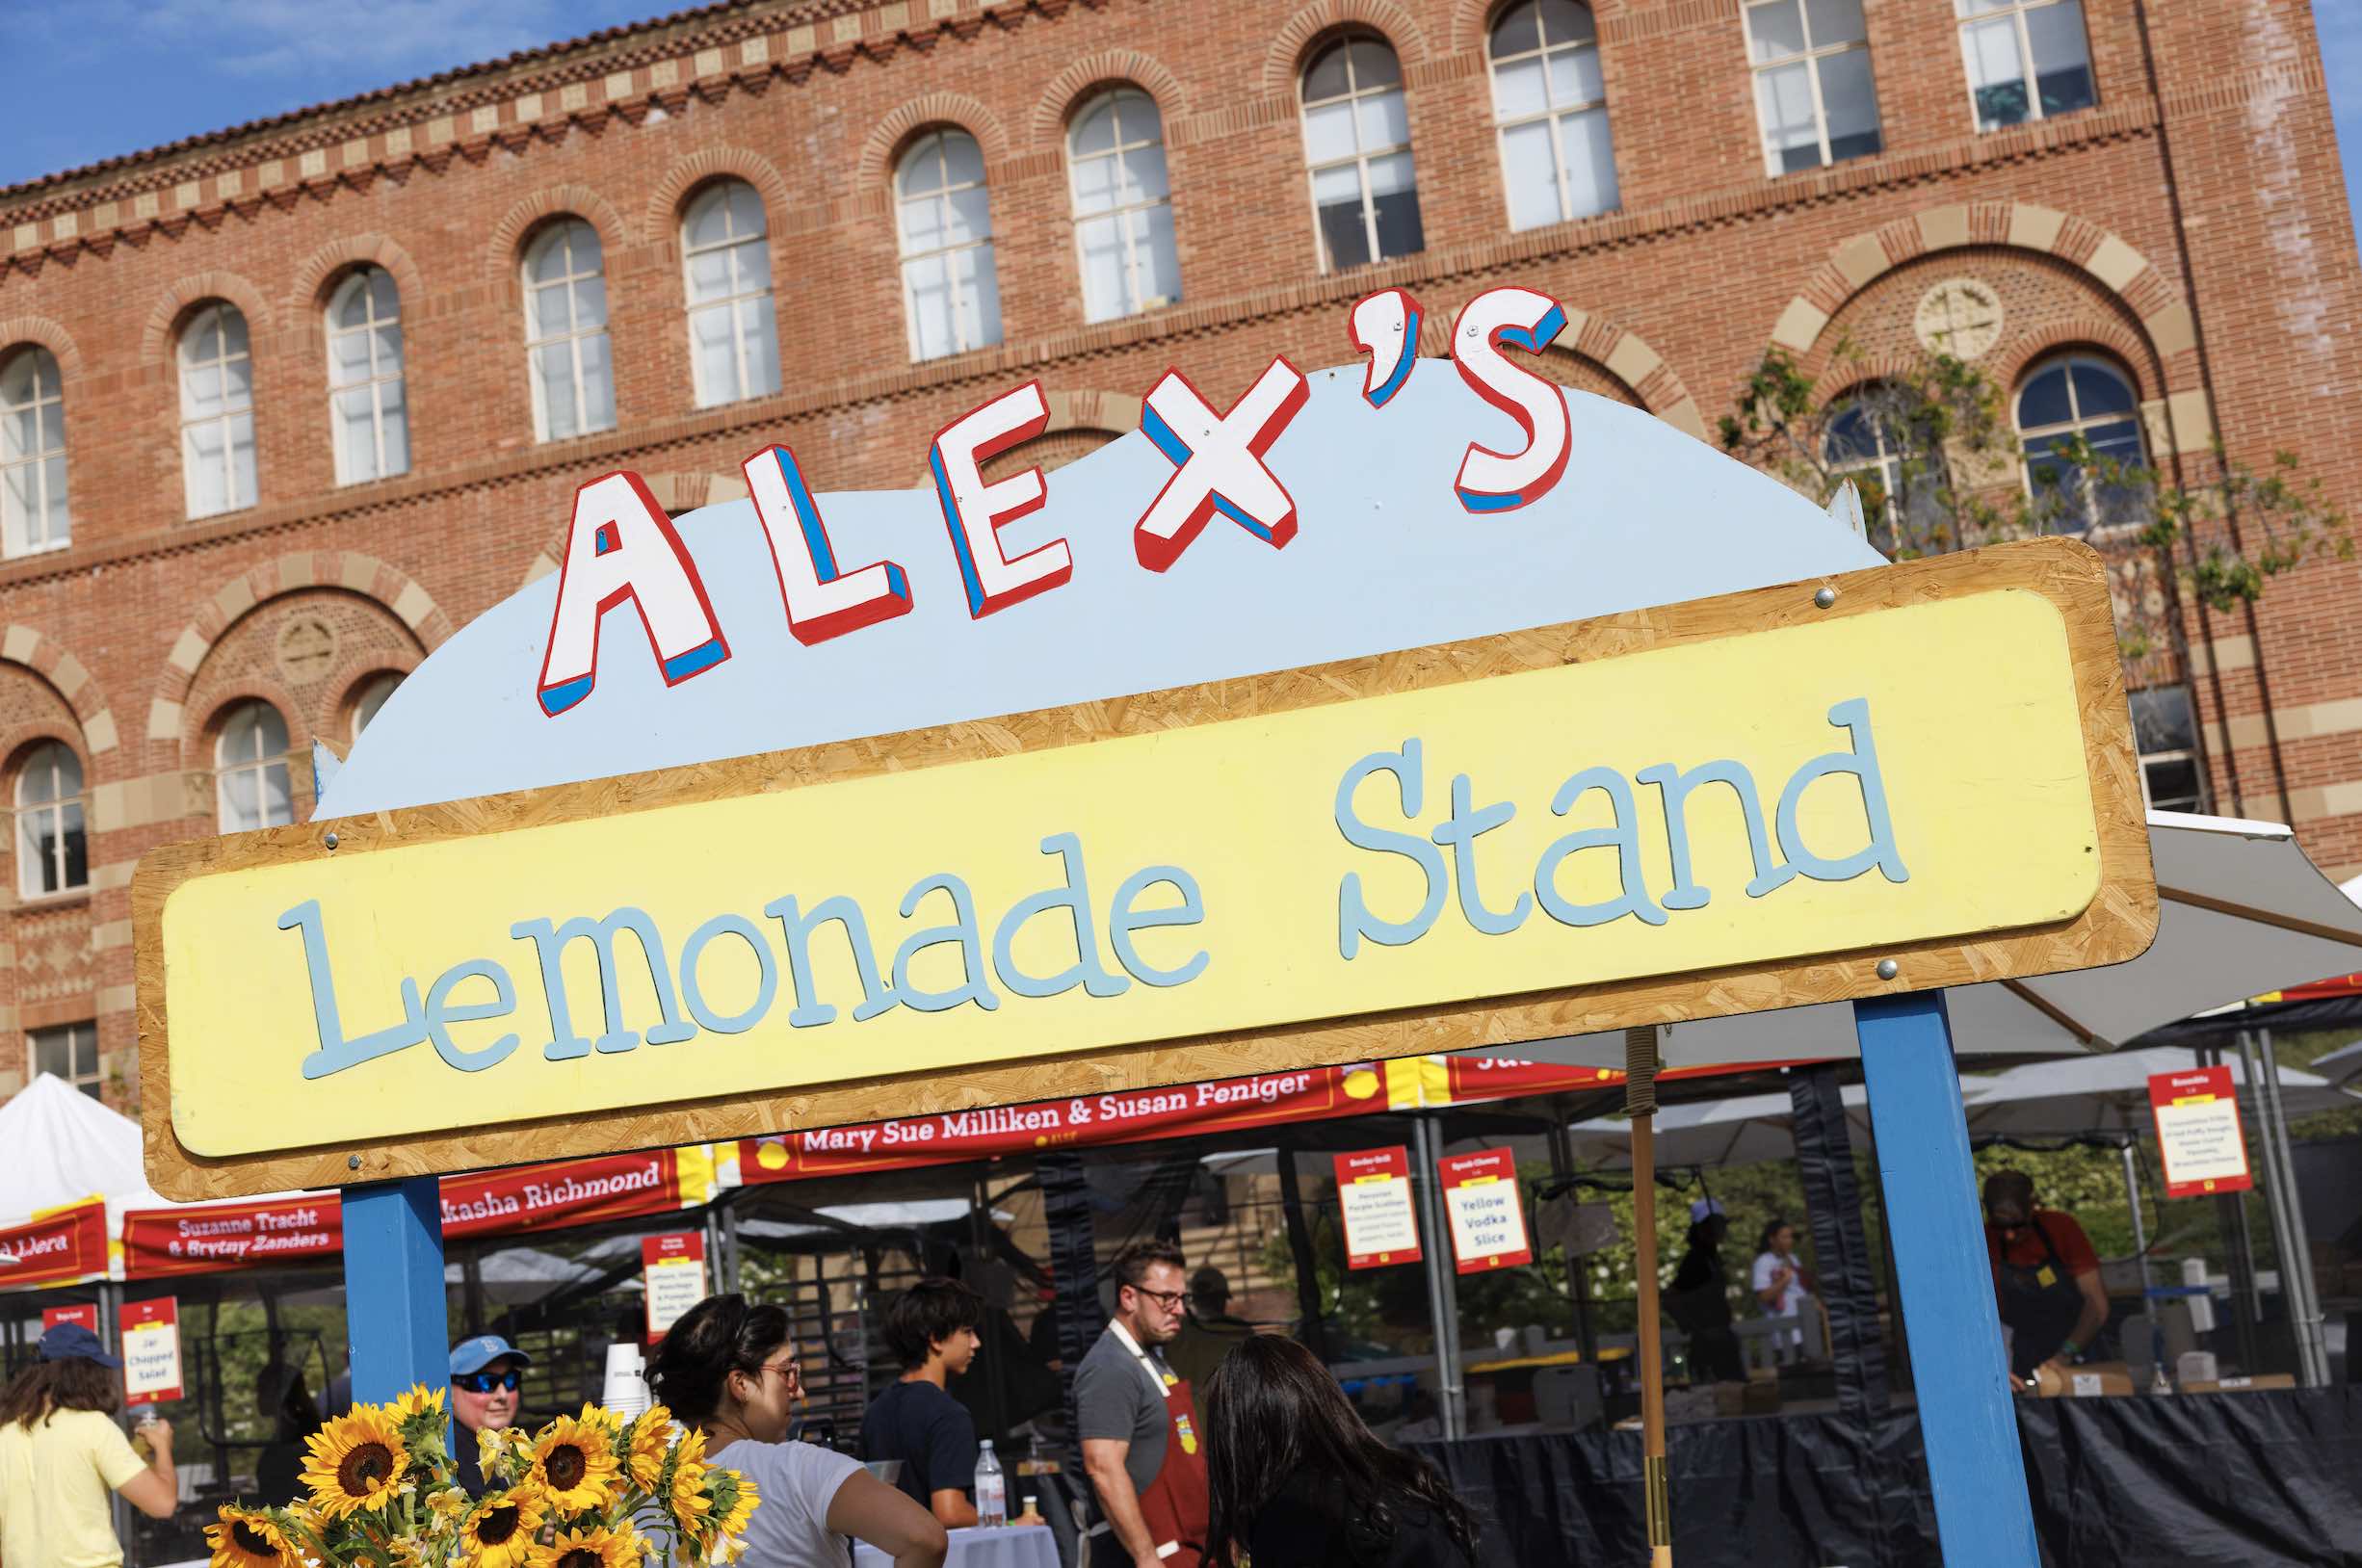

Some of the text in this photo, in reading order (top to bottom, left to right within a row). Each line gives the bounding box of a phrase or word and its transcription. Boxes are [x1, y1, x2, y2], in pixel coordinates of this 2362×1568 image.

[537, 285, 1570, 718] ALEX'S
[276, 696, 1910, 1082] Lemonade Stand
[803, 1129, 878, 1153] Mary
[882, 1121, 934, 1144] Sue
[941, 1107, 1061, 1139] Milliken
[1067, 1098, 1091, 1125] &
[1099, 1091, 1188, 1121] Susan
[1194, 1073, 1310, 1107] Feniger
[440, 1161, 661, 1224] kasha Richmond
[1461, 1197, 1506, 1211] Yellow
[178, 1208, 318, 1239] Suzanne Tracht
[1465, 1215, 1509, 1230] Vodka
[168, 1240, 182, 1257] &
[250, 1232, 329, 1252] Zanders
[1474, 1234, 1506, 1247] Slice
